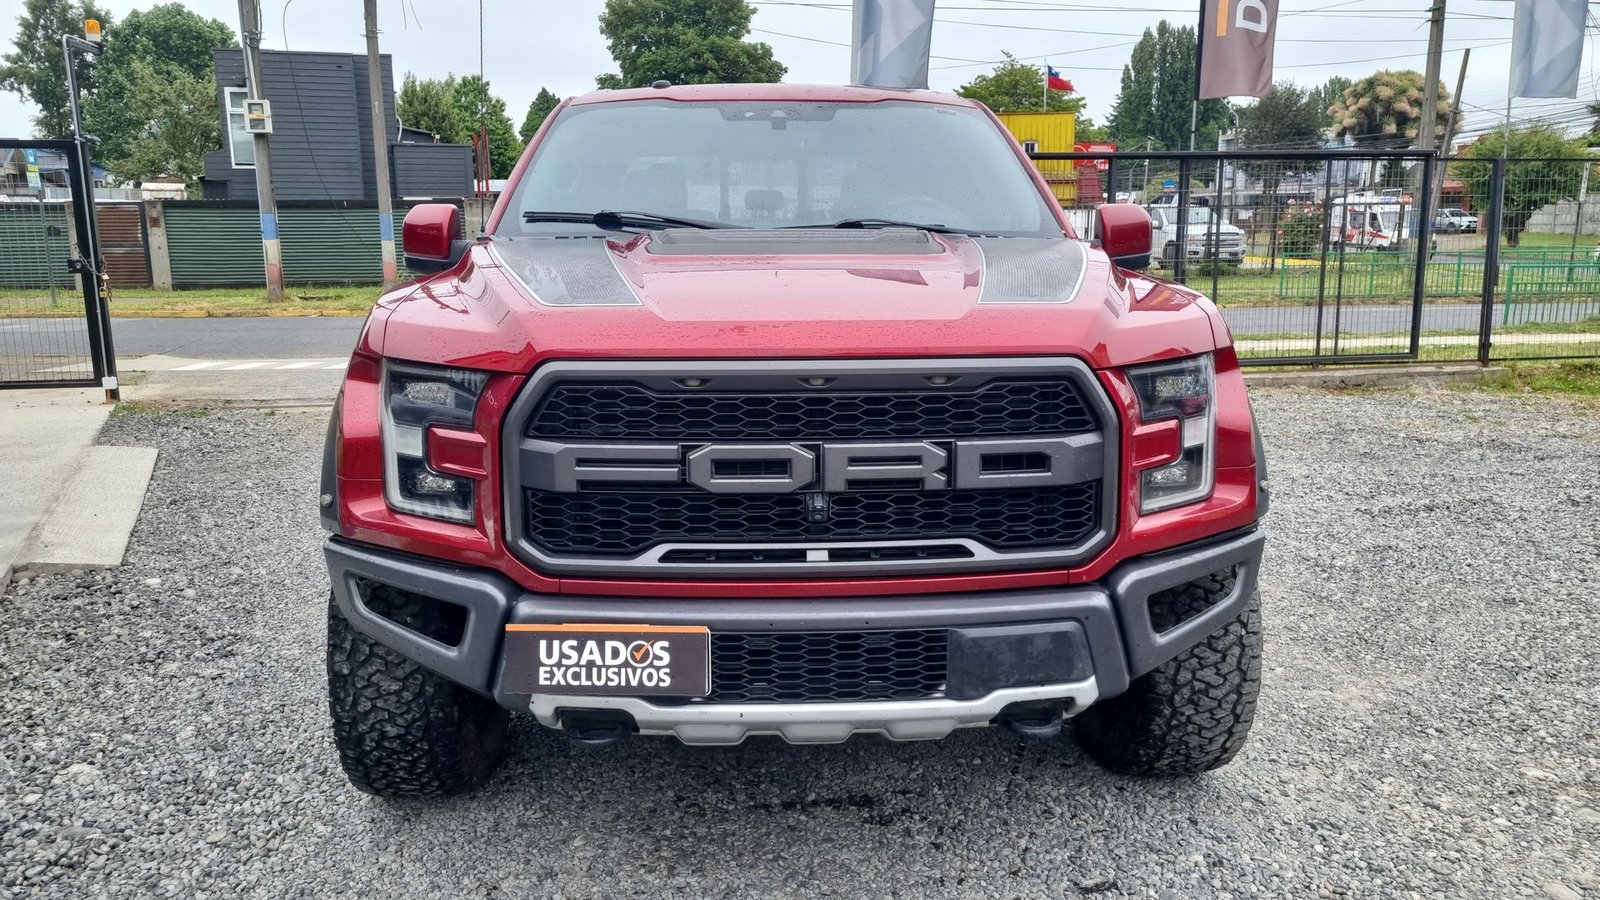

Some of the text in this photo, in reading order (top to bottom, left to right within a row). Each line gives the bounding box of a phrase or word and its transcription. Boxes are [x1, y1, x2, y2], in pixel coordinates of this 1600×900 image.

[520, 434, 1104, 494] FORD
[539, 640, 671, 667] USADOS
[538, 667, 671, 687] EXCLUSIVOS
